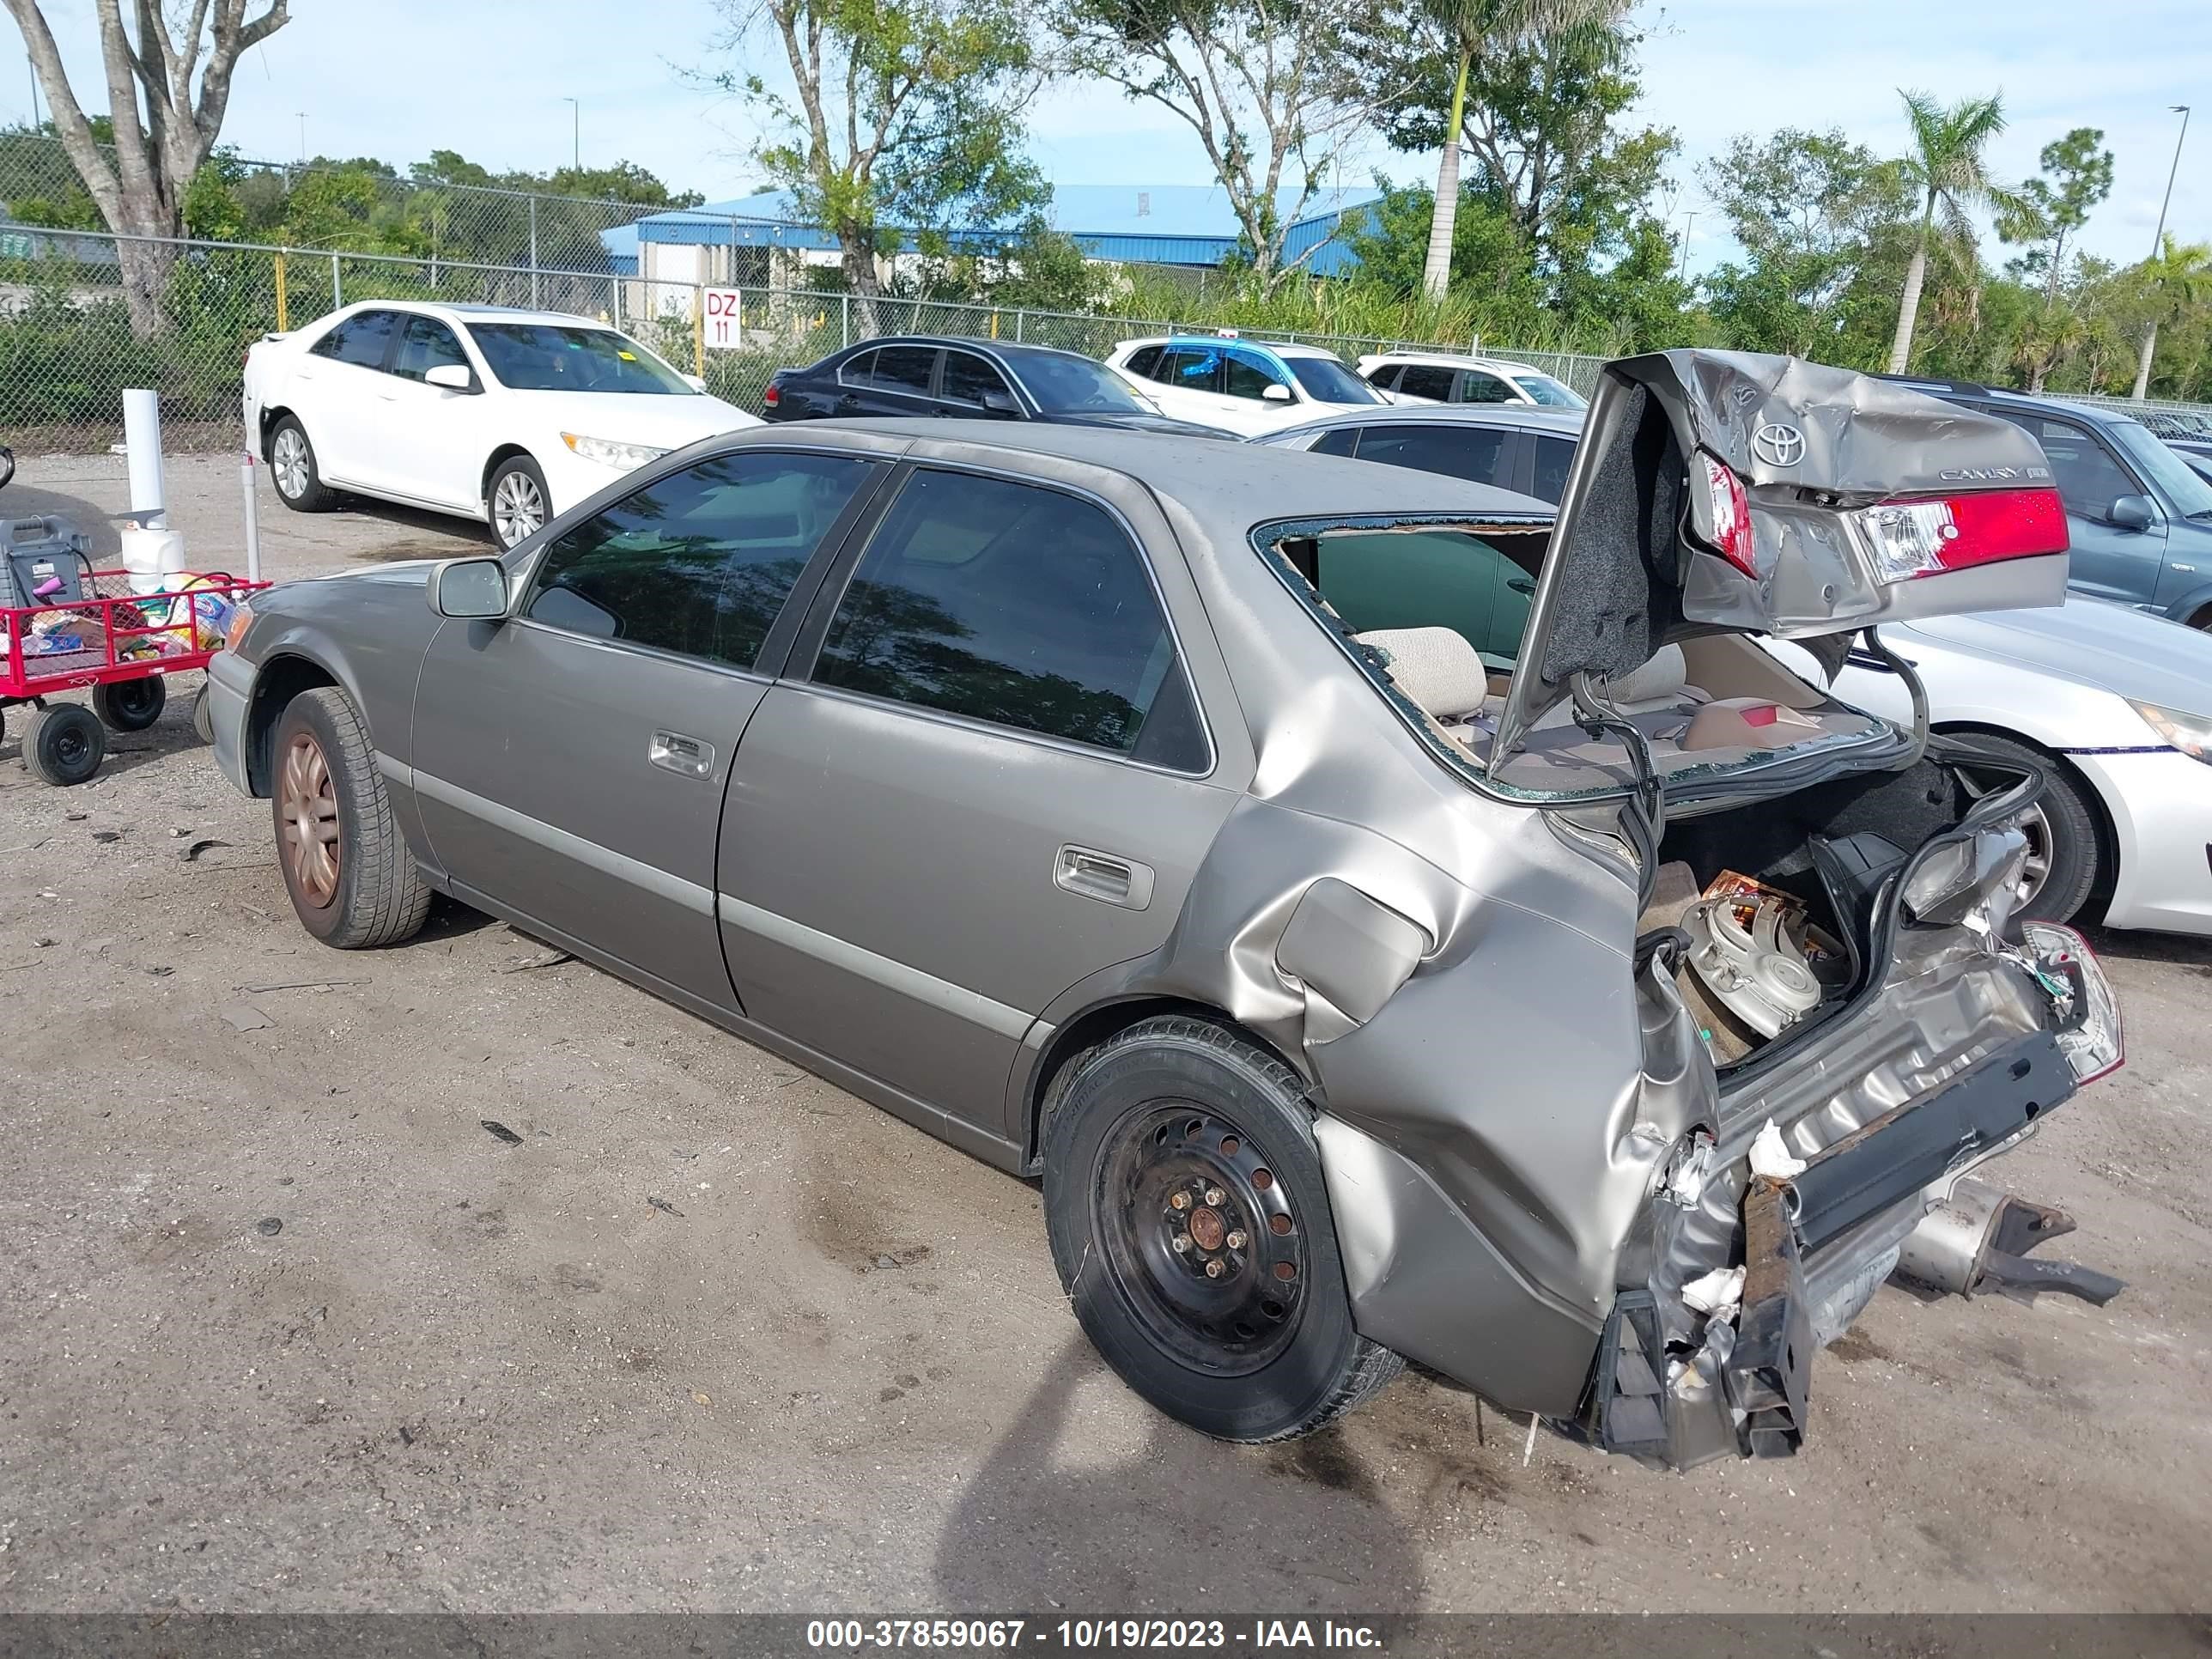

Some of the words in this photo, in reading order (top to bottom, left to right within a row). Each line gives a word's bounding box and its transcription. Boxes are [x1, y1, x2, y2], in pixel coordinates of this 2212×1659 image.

[708, 293, 737, 317] DZ
[715, 320, 728, 343] 11
[1939, 466, 2024, 481] CAMRY
